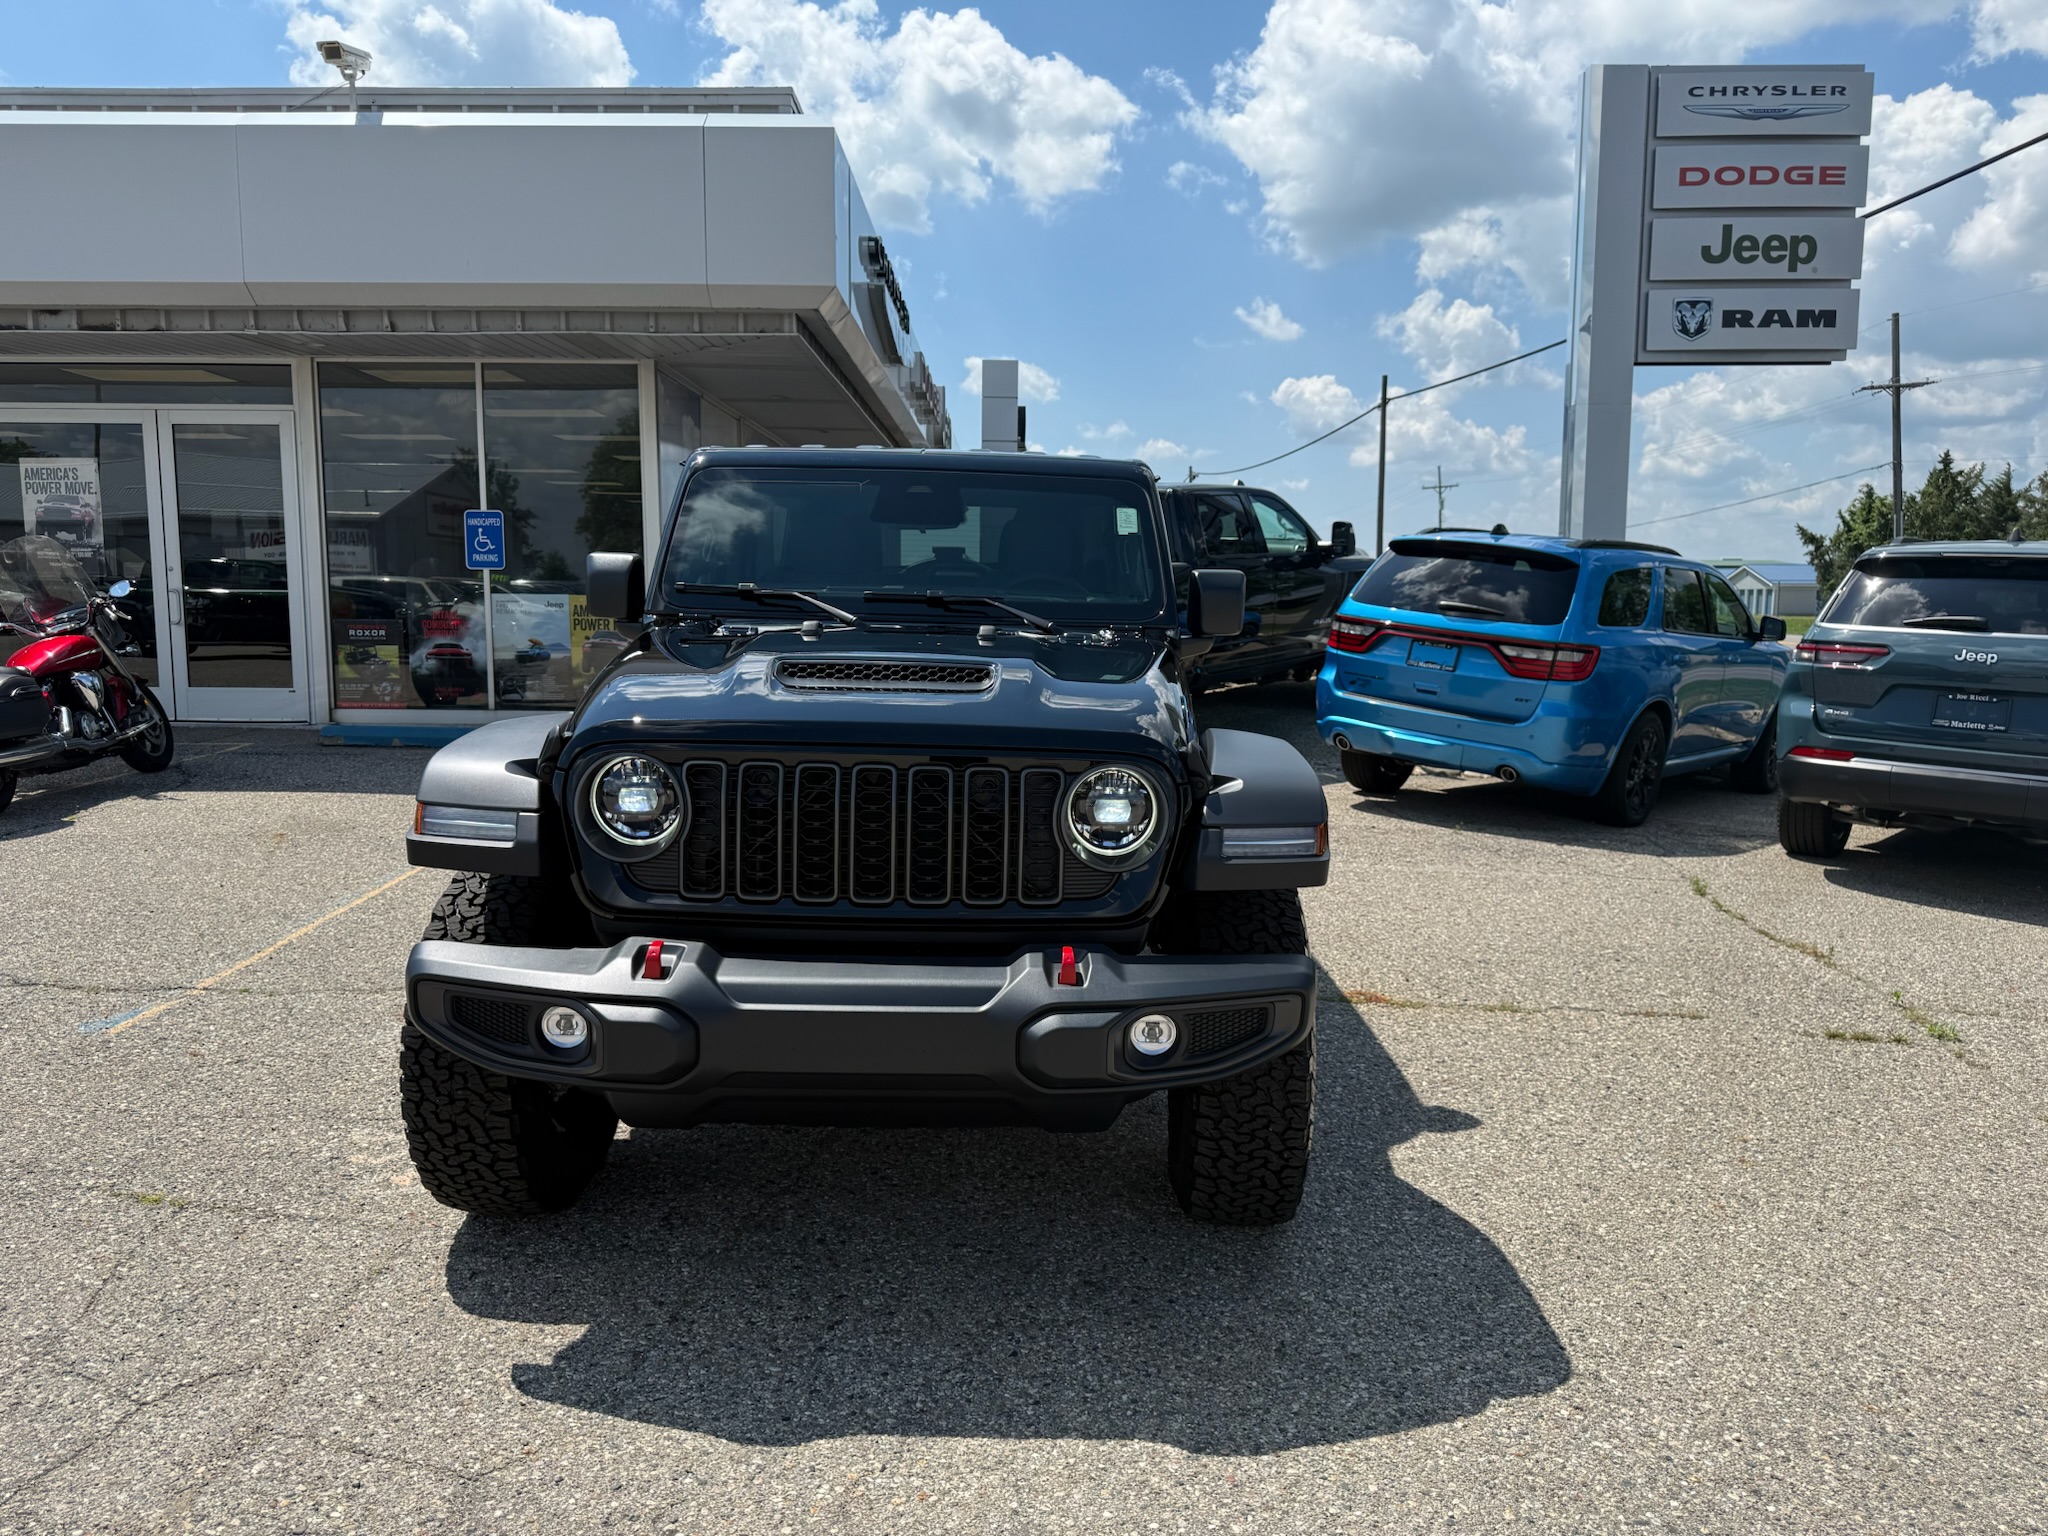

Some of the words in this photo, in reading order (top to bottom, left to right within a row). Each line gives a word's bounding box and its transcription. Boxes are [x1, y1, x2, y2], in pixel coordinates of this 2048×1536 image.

[1688, 85, 1847, 98] CHRYSLER
[1678, 165, 1847, 187] DODGE
[1700, 223, 1818, 273] Jeep
[1721, 309, 1837, 329] RAM
[24, 467, 79, 481] AMERICA'S
[25, 481, 62, 495] POWER
[64, 481, 97, 495] MOVE.
[467, 517, 501, 527] HANDICAPPED
[472, 553, 499, 563] PARKING
[544, 600, 564, 609] Jeep
[573, 618, 610, 632] POWER
[348, 629, 386, 637] ROXOR
[1954, 648, 1998, 666] Jeep
[1969, 694, 1990, 702] Ricci
[1950, 720, 1986, 730] Marlette
